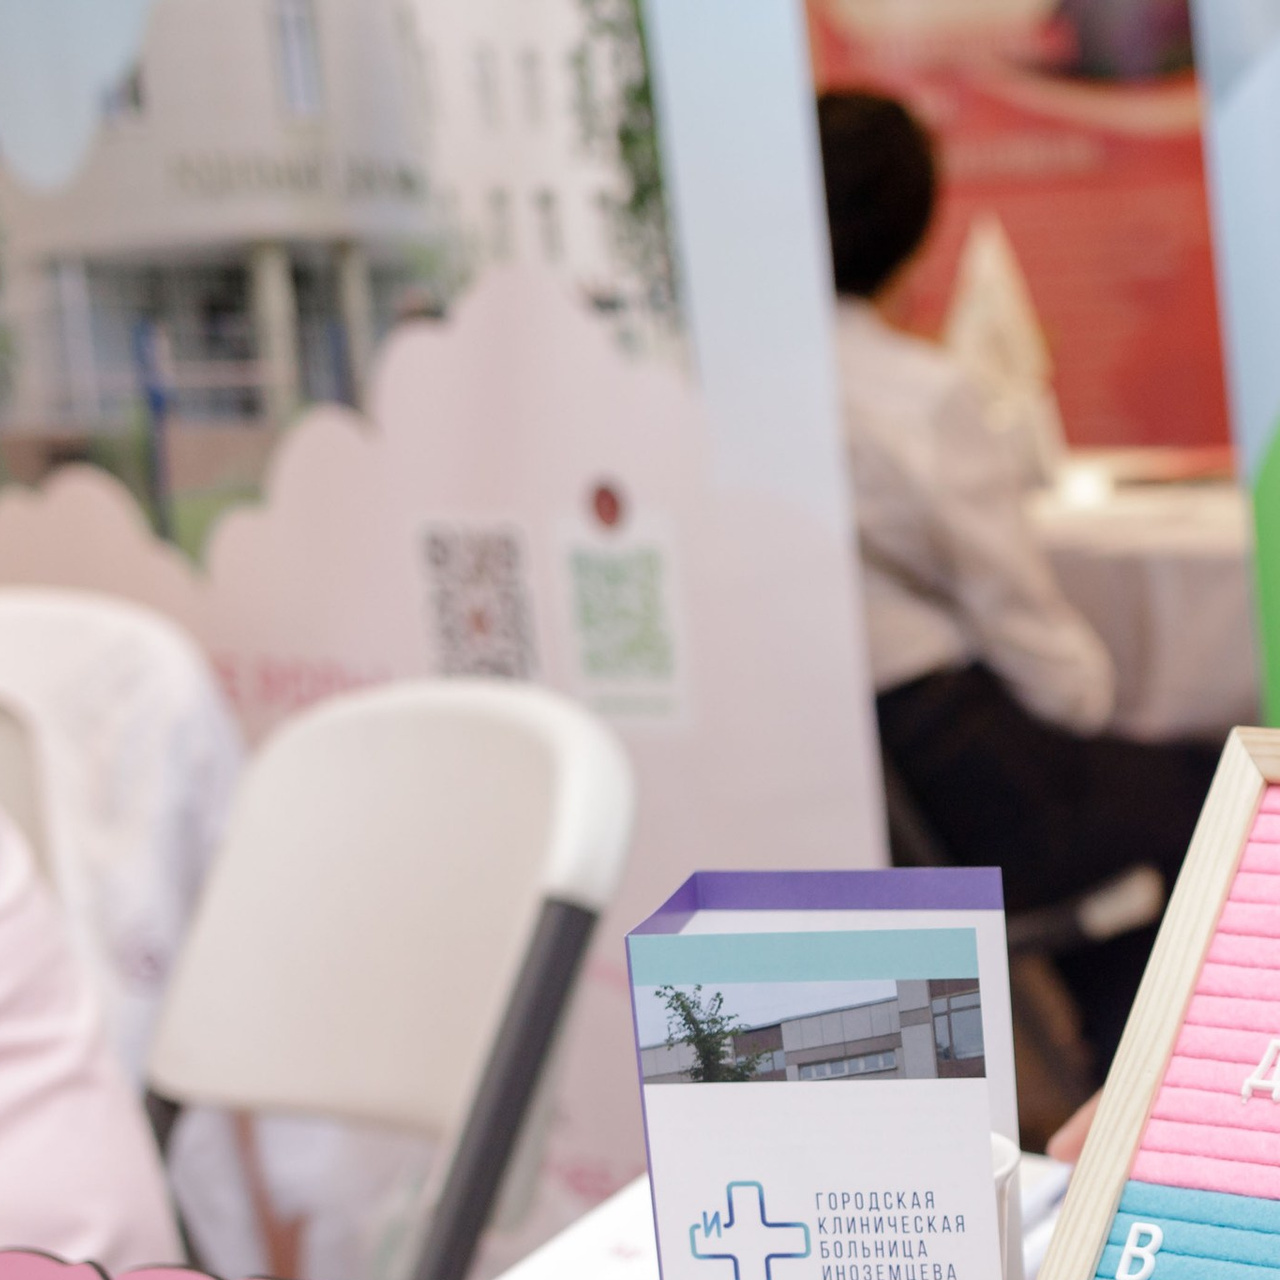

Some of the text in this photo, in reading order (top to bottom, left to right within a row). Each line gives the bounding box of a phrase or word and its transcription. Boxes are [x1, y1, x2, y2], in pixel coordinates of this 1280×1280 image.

[815, 1190, 935, 1212] ГОРОДСКАЯ
[817, 1214, 966, 1235] КЛИНИЧЕСКАЯ
[819, 1239, 929, 1260] БОЛЬНИЦА
